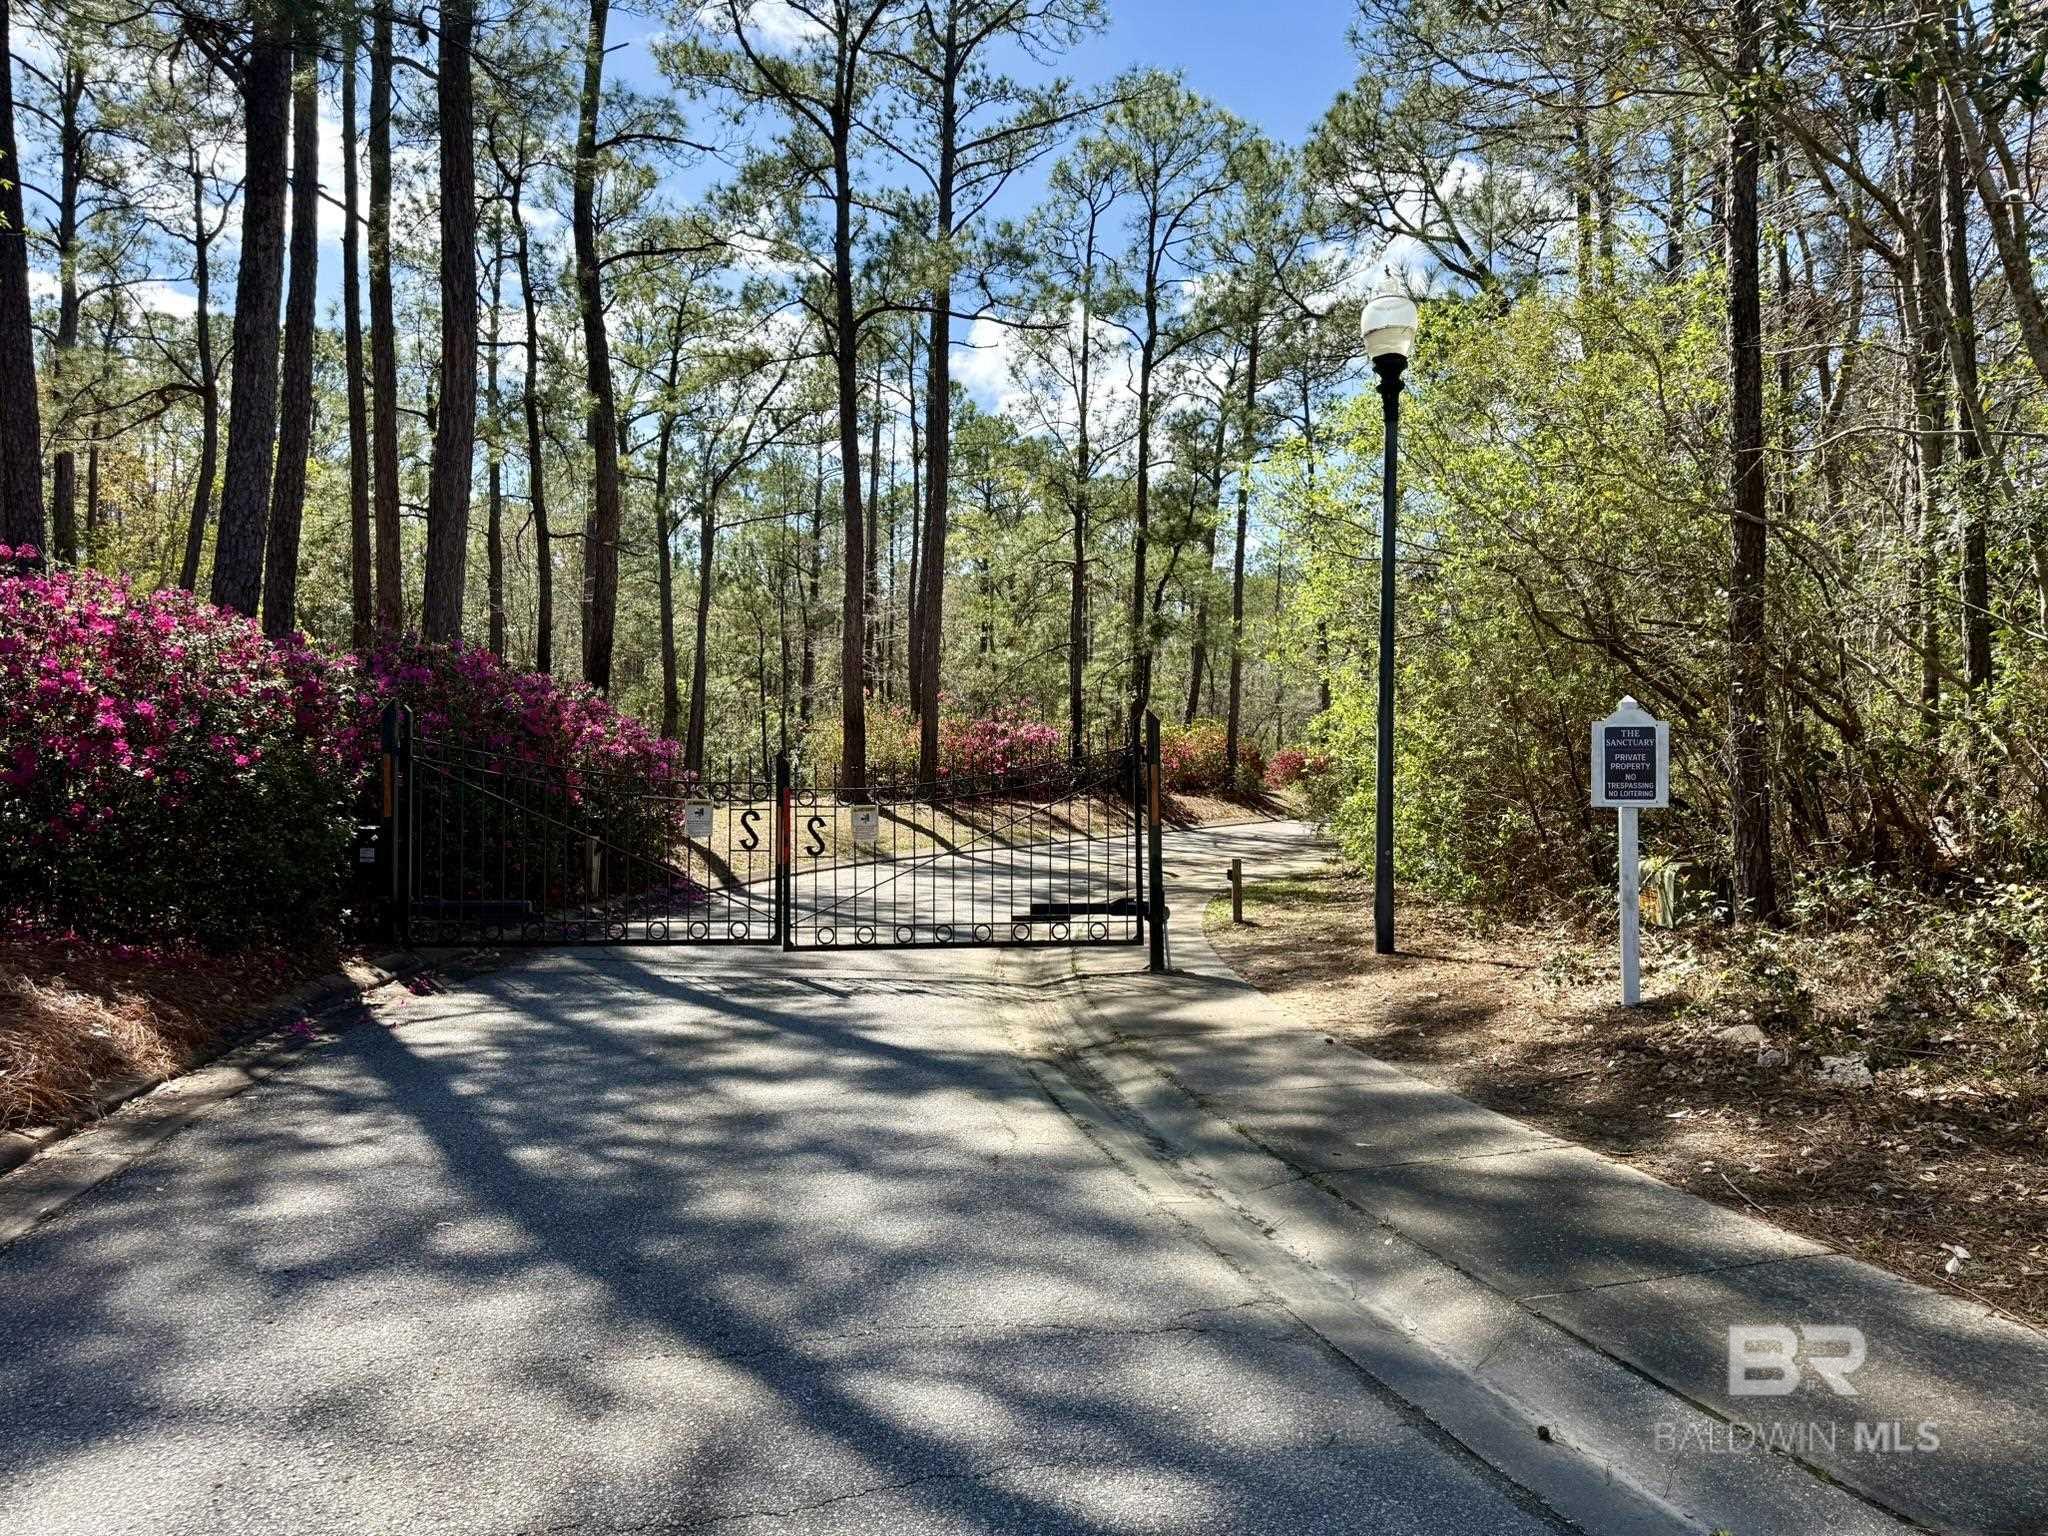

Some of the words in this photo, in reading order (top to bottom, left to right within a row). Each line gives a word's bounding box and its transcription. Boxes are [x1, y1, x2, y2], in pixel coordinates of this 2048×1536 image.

[1620, 729, 1641, 738] THE
[1606, 739, 1655, 747] SANCTUARY
[1615, 753, 1646, 761] PRIVATE
[1610, 762, 1650, 770] PROPERTY
[1625, 773, 1637, 781] NO
[1607, 782, 1654, 790] TRESPASSING
[1608, 790, 1618, 798] NO
[1620, 790, 1654, 798] LOITERING
